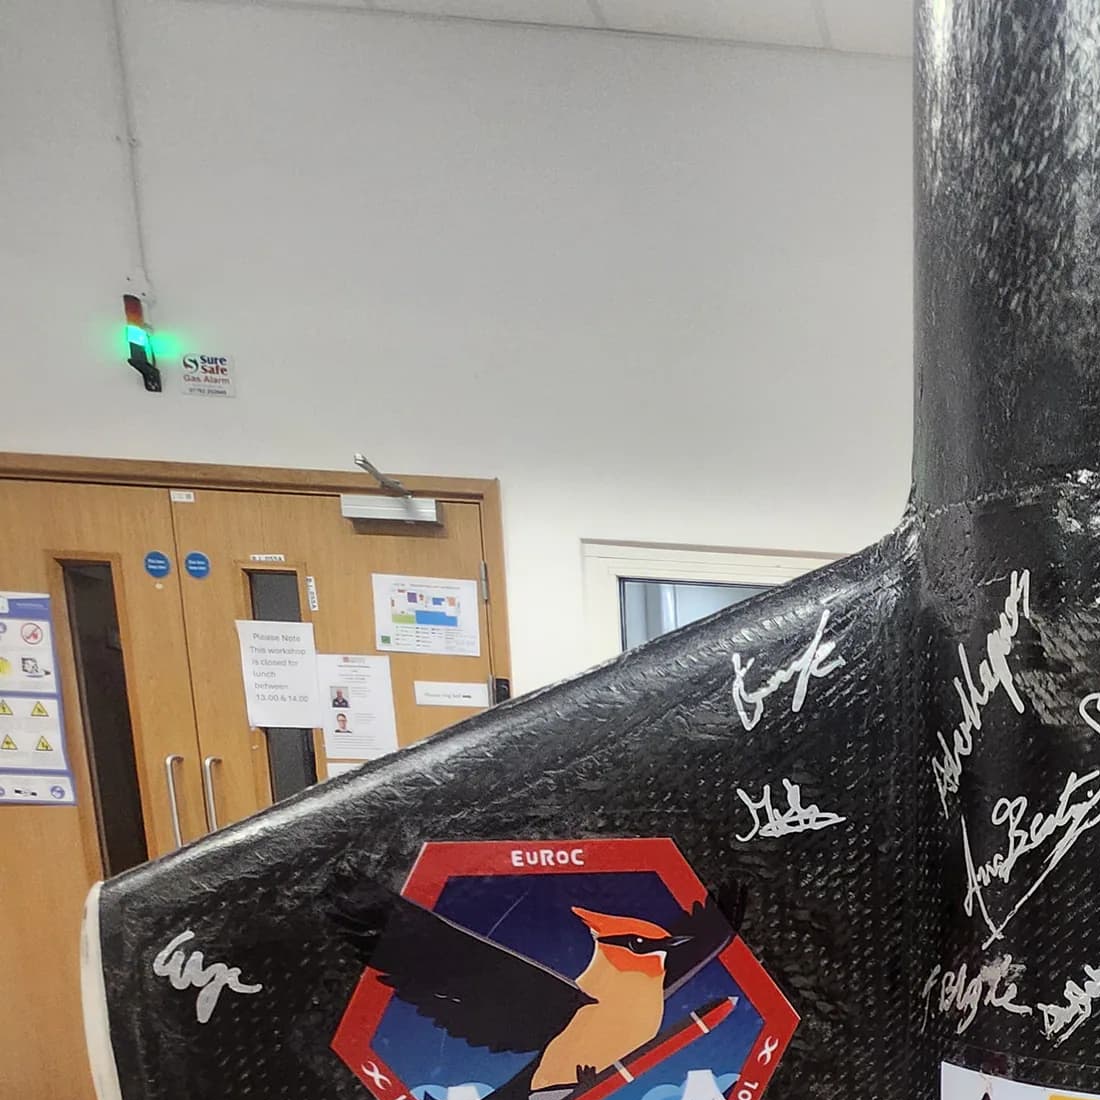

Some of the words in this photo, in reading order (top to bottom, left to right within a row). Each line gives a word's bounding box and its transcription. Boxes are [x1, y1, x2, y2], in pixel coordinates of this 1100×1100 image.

[200, 355, 228, 365] Sure
[200, 365, 229, 376] Safe
[203, 376, 230, 384] Alarm
[252, 633, 280, 641] Please
[281, 634, 301, 642] Note
[250, 646, 266, 654] This
[268, 647, 306, 655] workshop
